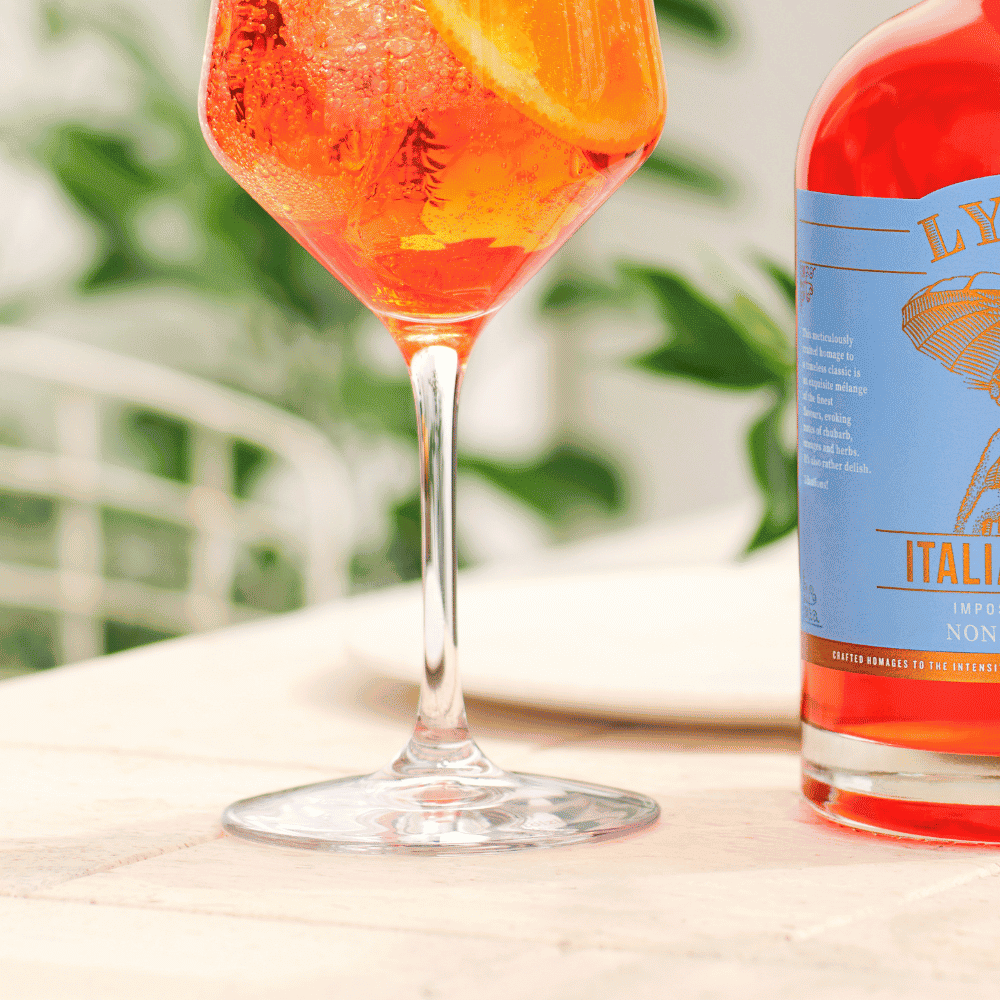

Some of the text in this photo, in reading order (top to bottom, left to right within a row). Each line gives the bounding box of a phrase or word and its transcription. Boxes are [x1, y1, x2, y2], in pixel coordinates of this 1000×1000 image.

[846, 352, 854, 361] to
[828, 365, 852, 377] classic
[853, 367, 861, 378] is
[835, 381, 868, 396] mélange
[824, 412, 852, 427] evoking
[835, 444, 860, 457] herbs.
[844, 461, 872, 474] delish.
[832, 650, 864, 664] CRAFTED
[866, 656, 909, 669] HOMAGES
[913, 660, 925, 670] TO
[929, 661, 948, 671] THE
